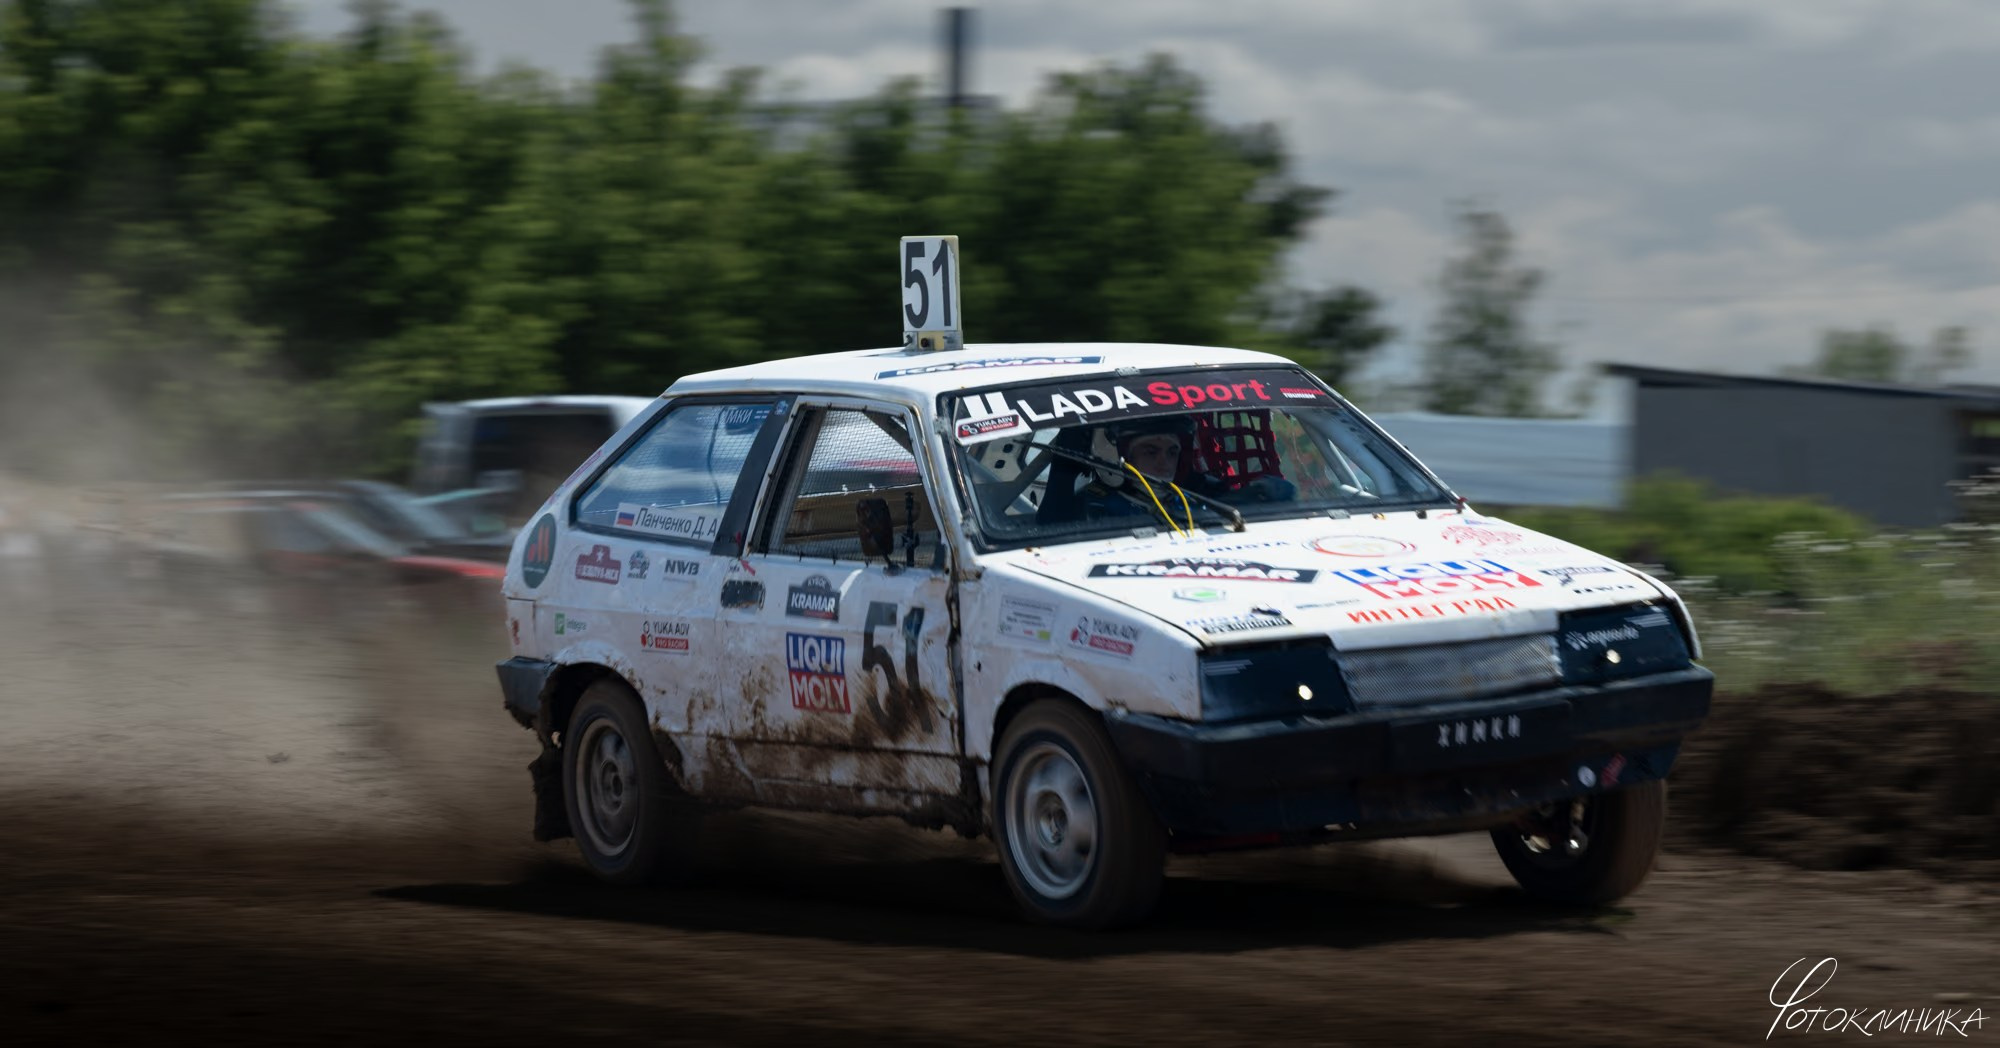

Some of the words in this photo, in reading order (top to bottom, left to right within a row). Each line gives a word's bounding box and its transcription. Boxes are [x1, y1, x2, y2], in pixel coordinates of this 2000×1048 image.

[905, 239, 951, 329] 51
[1017, 385, 1149, 423] LADA
[1147, 379, 1271, 409] Sport
[635, 507, 691, 533] Панченко
[664, 559, 700, 576] NWB
[1105, 565, 1301, 581] KRAMAR
[1341, 559, 1507, 584] LIQUI
[1370, 572, 1528, 599] MOLY
[791, 592, 836, 612] KRAMAR
[1346, 596, 1517, 624] ИНТЕГРАЛ
[653, 621, 673, 636] YUKA
[674, 622, 690, 636] ADV
[788, 635, 843, 674] LIQUI
[862, 601, 935, 735] 51
[791, 673, 846, 711] MOLY
